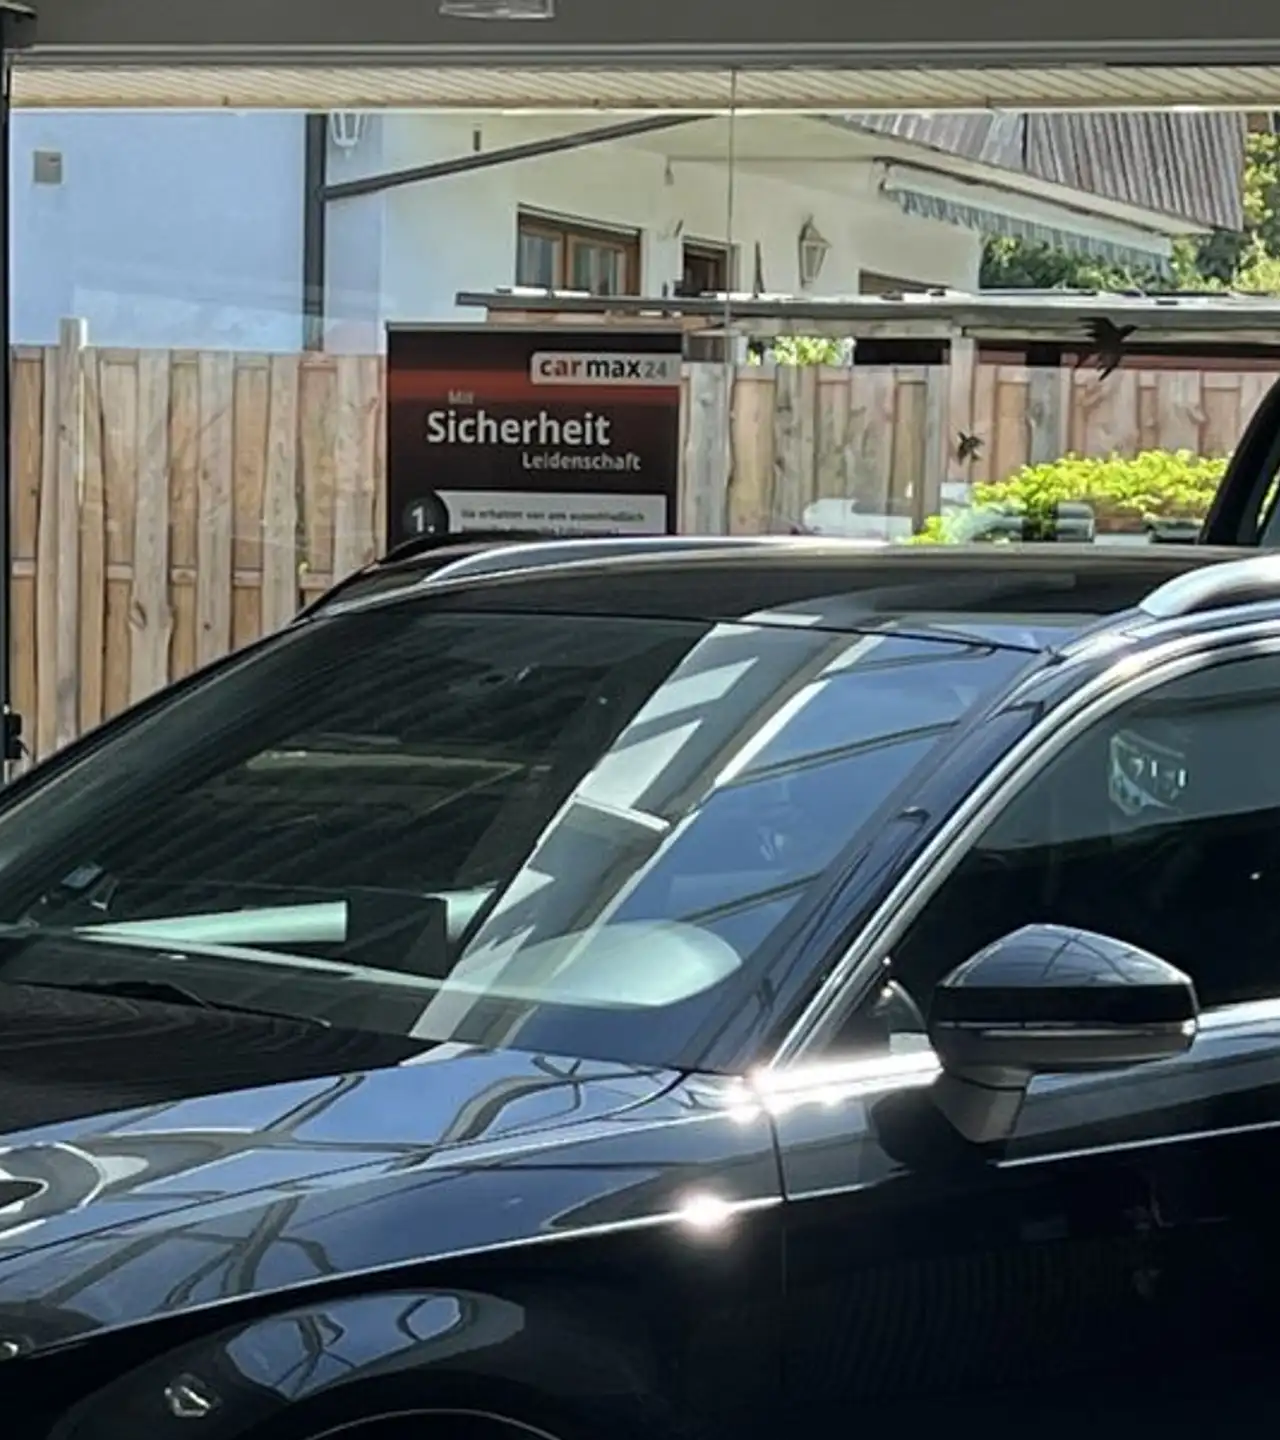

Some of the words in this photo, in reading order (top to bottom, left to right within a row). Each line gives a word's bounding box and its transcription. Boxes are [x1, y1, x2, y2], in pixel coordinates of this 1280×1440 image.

[426, 410, 611, 446] Sicherheit
[522, 452, 642, 471] Leidenschaft
[411, 506, 435, 533] 1.
